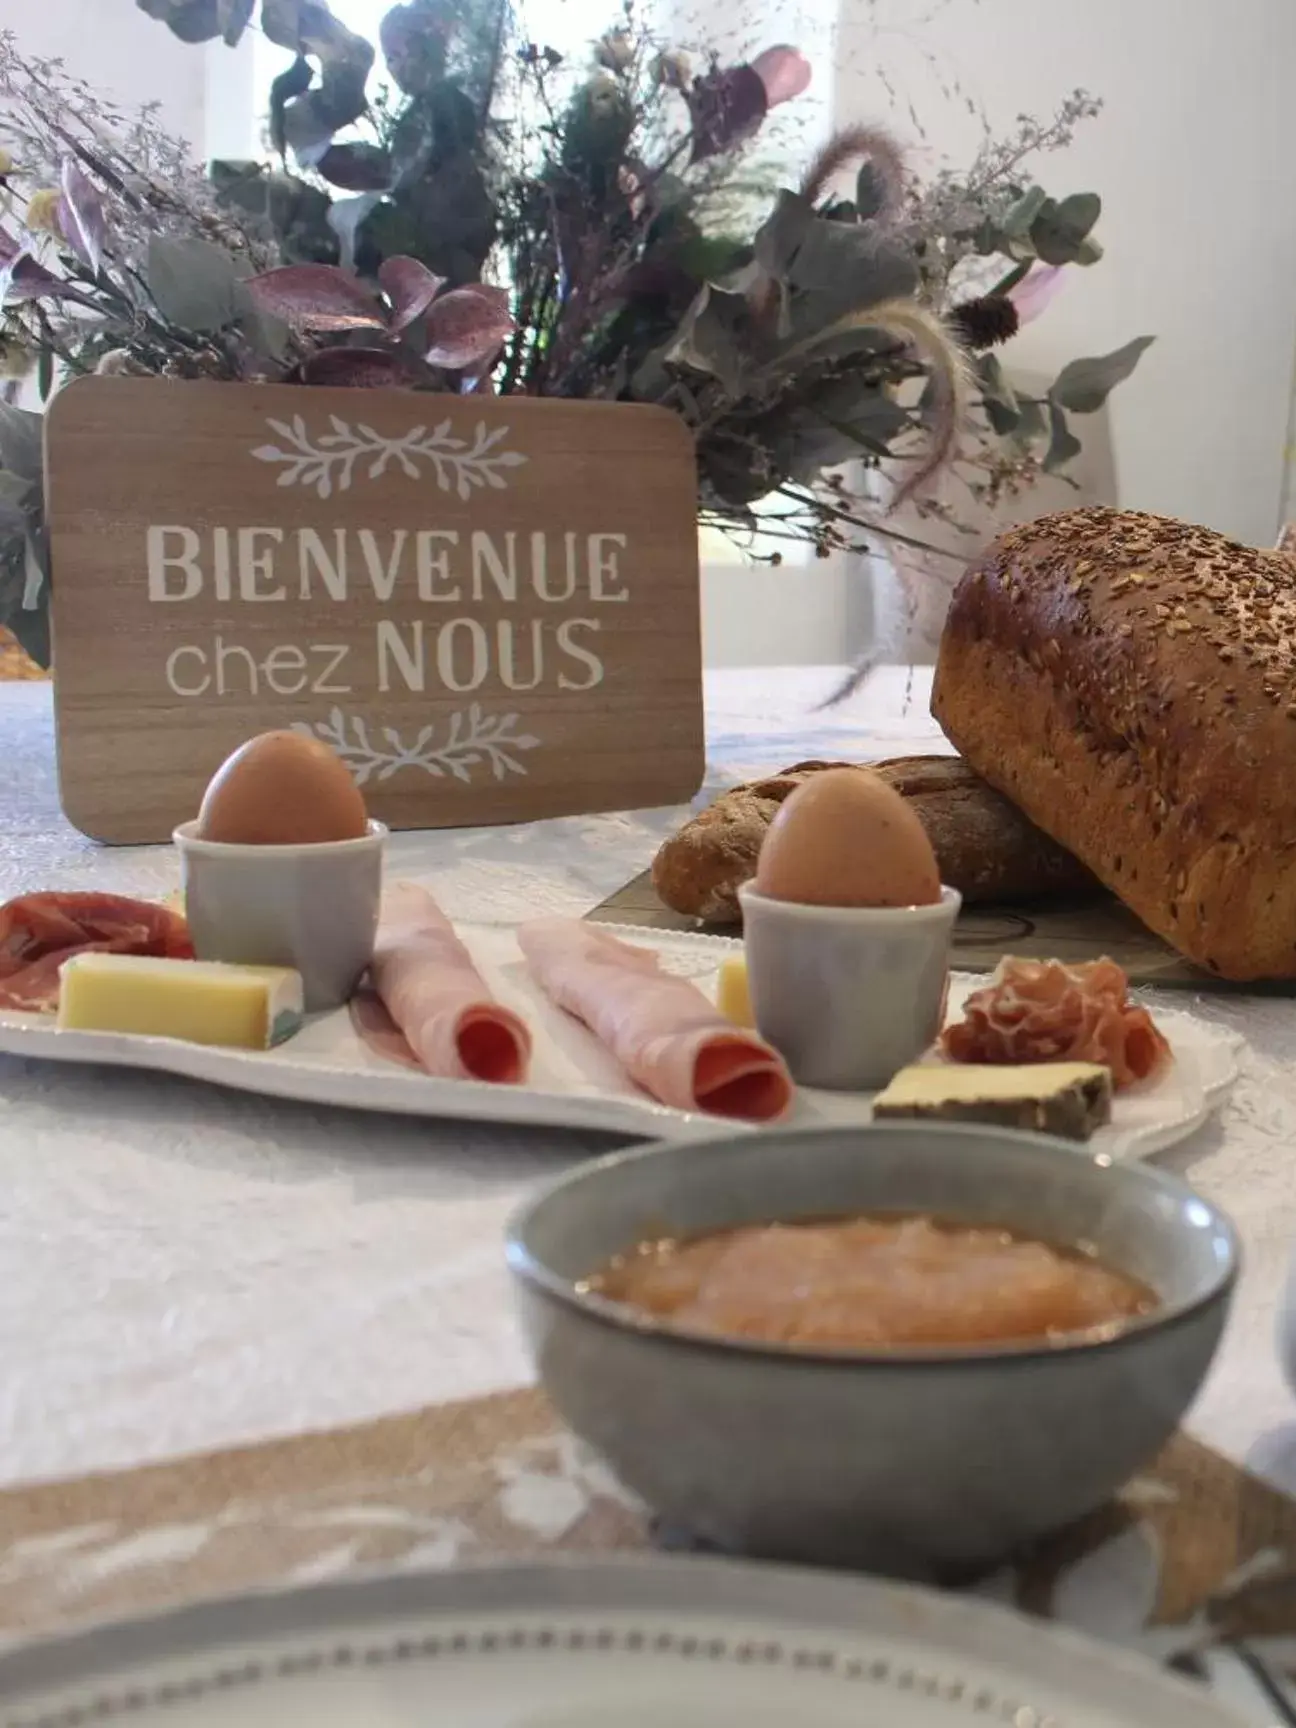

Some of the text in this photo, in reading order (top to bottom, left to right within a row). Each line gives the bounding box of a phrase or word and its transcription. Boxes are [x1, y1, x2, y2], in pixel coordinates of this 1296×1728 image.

[146, 525, 630, 602] BIENVENUE
[166, 617, 604, 696] chez NOUS
